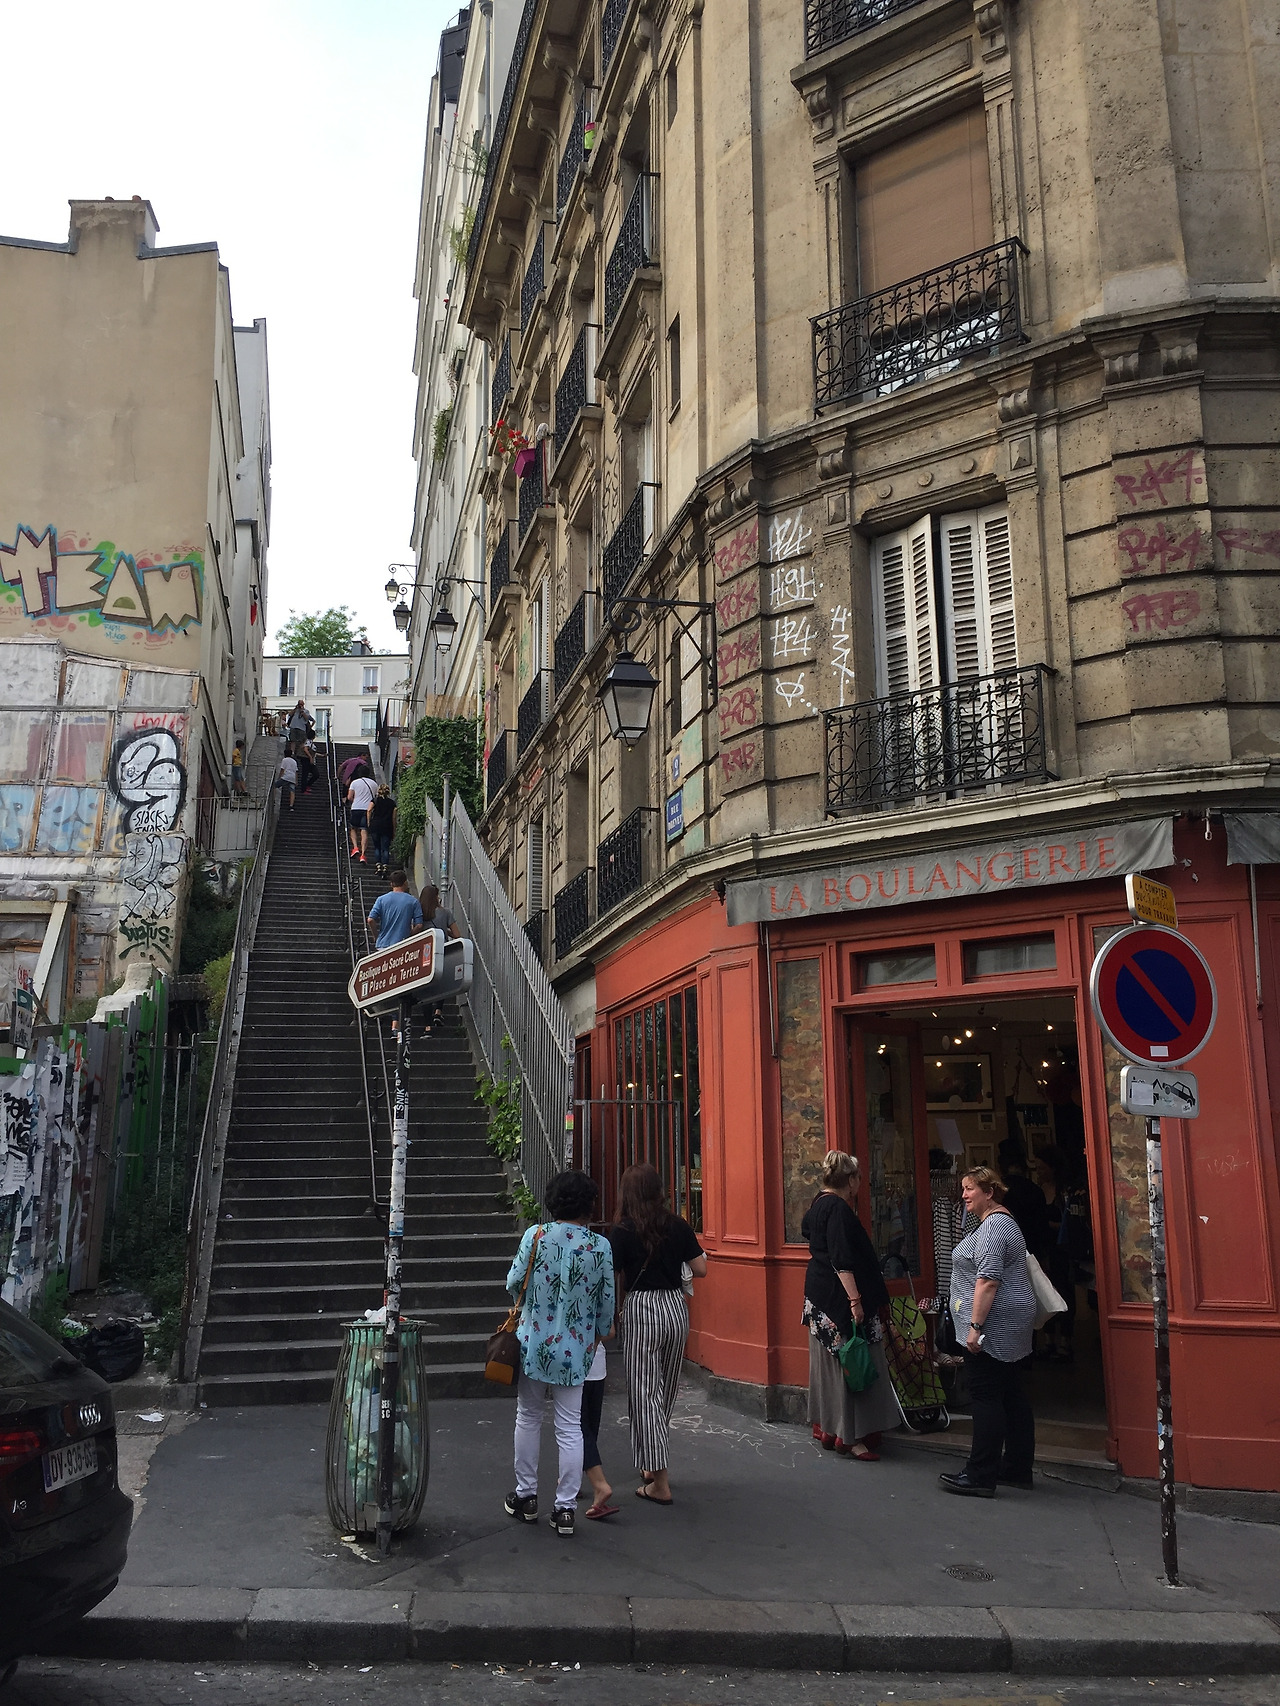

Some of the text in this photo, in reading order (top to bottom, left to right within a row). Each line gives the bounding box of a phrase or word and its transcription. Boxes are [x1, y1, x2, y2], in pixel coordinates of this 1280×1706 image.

[670, 803, 679, 815] RUE
[769, 836, 1117, 914] LA BOULANGERIE
[1145, 883, 1167, 899] COMPTER
[1138, 904, 1175, 925] POUR TRAVAUX
[359, 965, 381, 982] Basilique
[382, 961, 388, 972] du
[389, 954, 404, 970] Sacré
[369, 965, 420, 993] Place du Tertre
